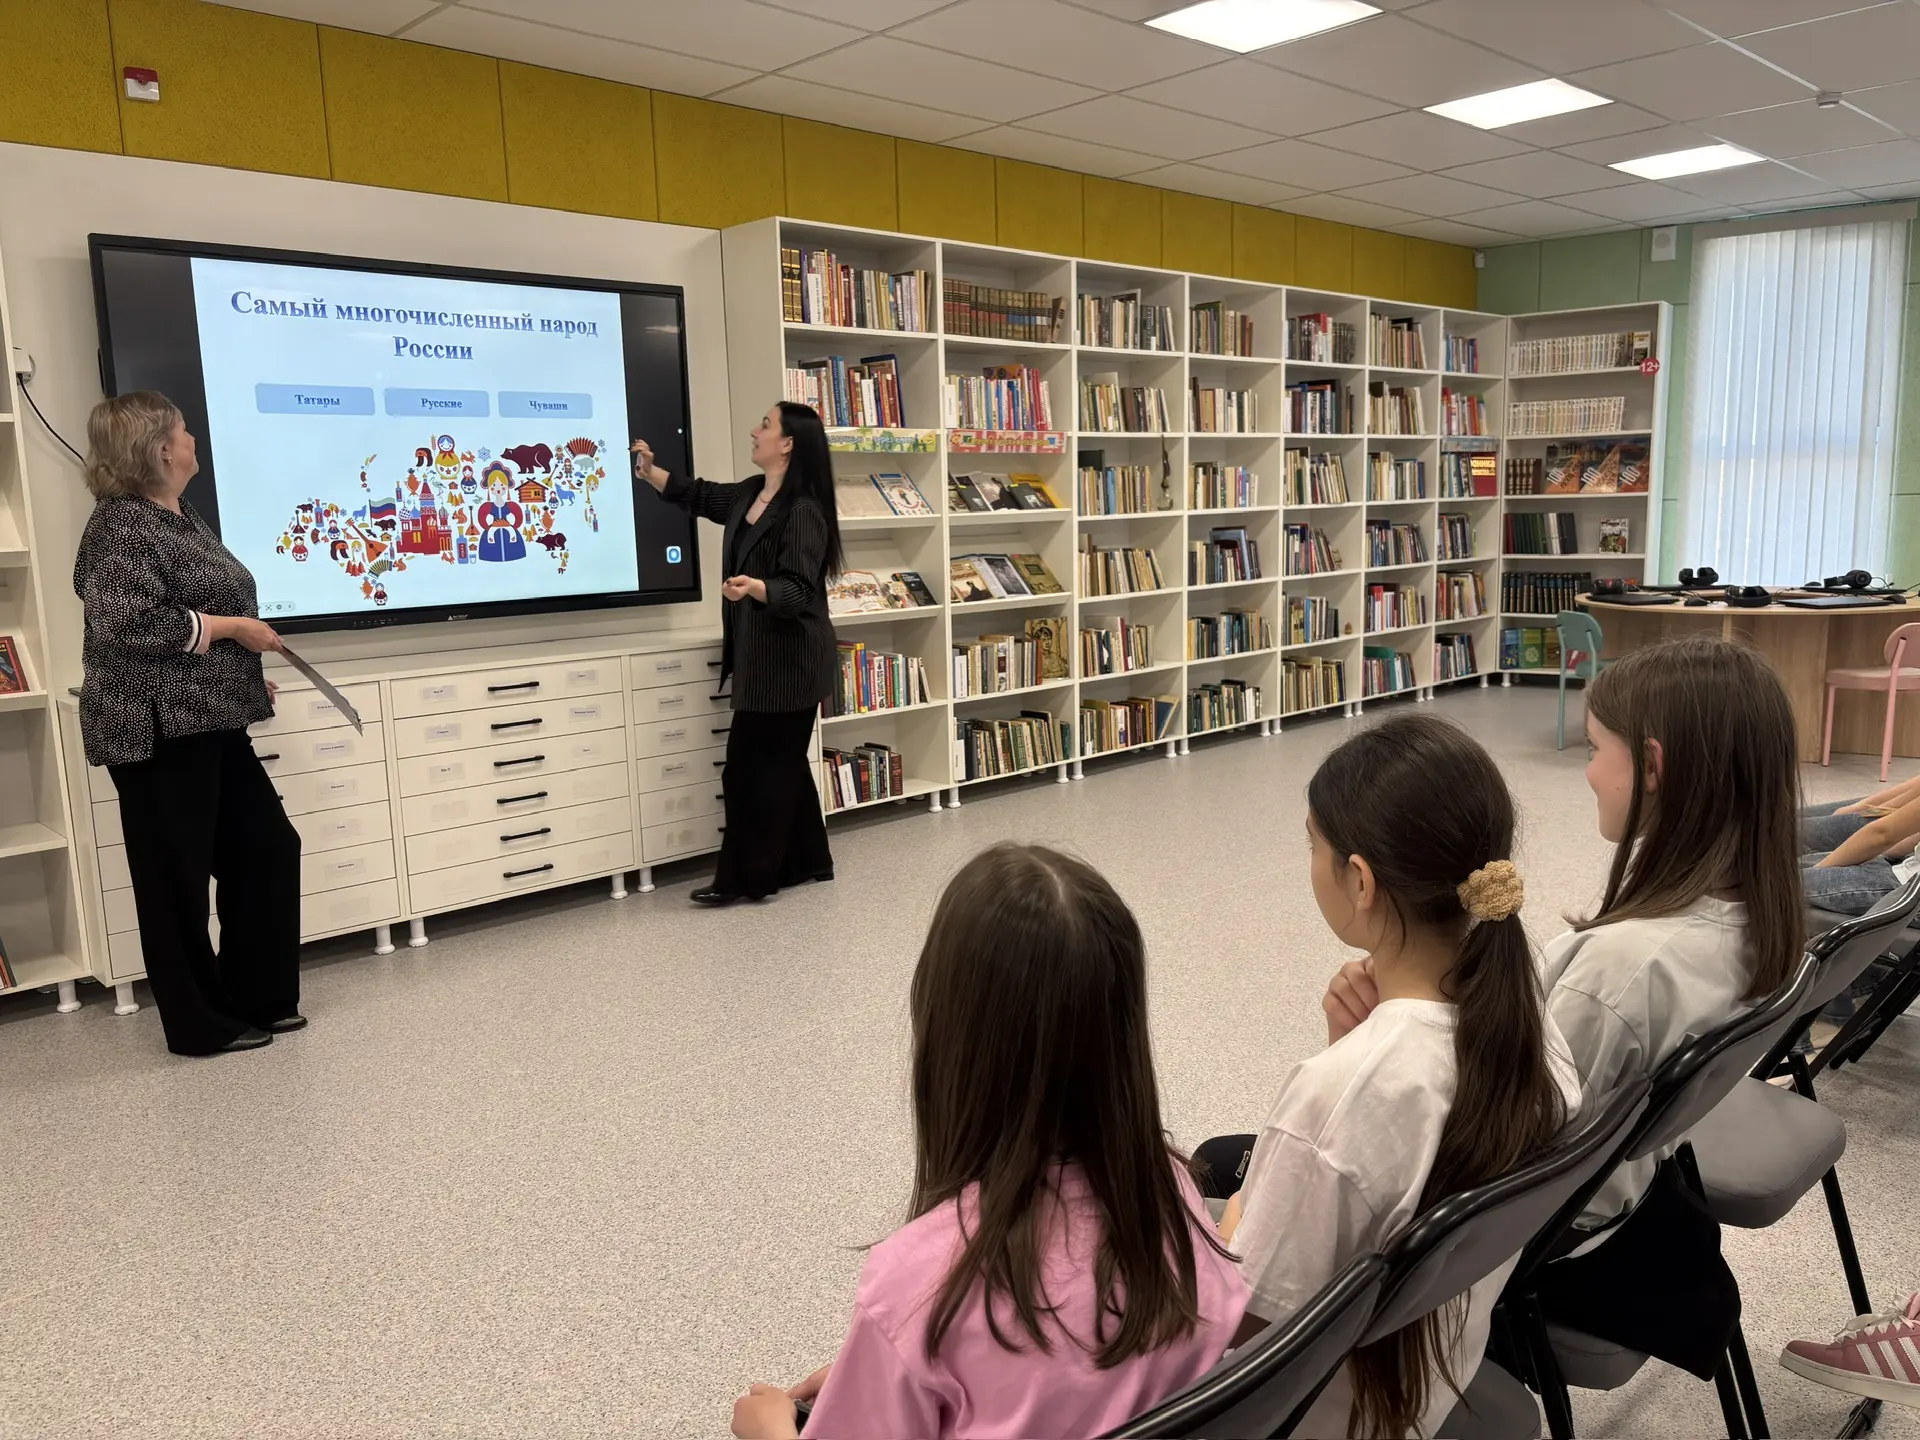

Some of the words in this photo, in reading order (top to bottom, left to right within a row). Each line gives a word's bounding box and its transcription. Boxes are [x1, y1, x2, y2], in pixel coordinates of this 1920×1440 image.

[231, 289, 328, 319] Самый
[336, 303, 534, 332] многочисленный
[540, 312, 599, 338] народ
[393, 336, 474, 360] России
[1640, 361, 1658, 372] 12+
[294, 394, 340, 406] Татары
[421, 397, 463, 409] Русские
[529, 400, 568, 411] Чуваши
[1546, 469, 1565, 485] 100
[1581, 466, 1601, 486] 100
[1619, 465, 1640, 486] 100
